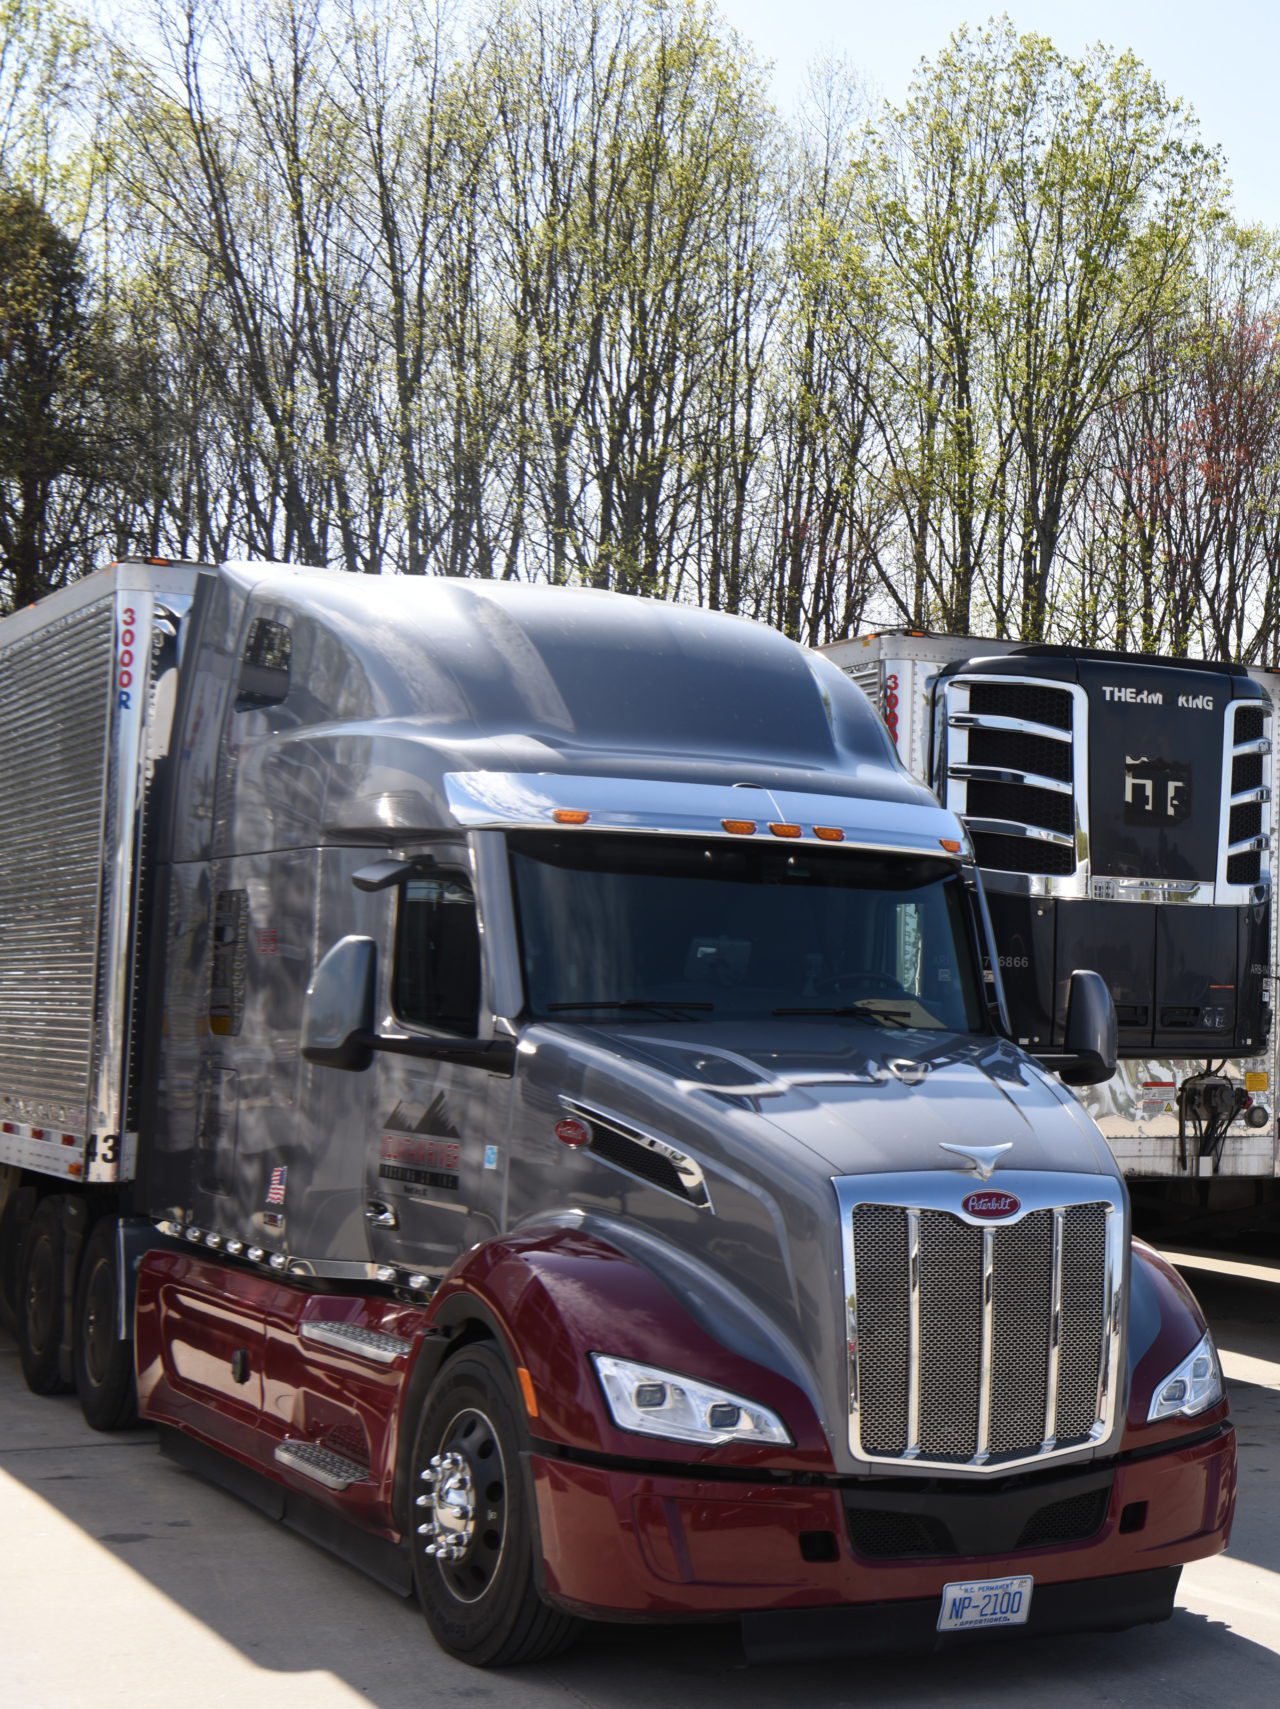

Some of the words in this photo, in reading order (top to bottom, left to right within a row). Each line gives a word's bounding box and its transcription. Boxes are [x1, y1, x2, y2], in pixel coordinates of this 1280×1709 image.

[118, 607, 136, 710] 3000R
[968, 1195, 1015, 1212] Peterbilt
[949, 1591, 1023, 1620] NP-2100
